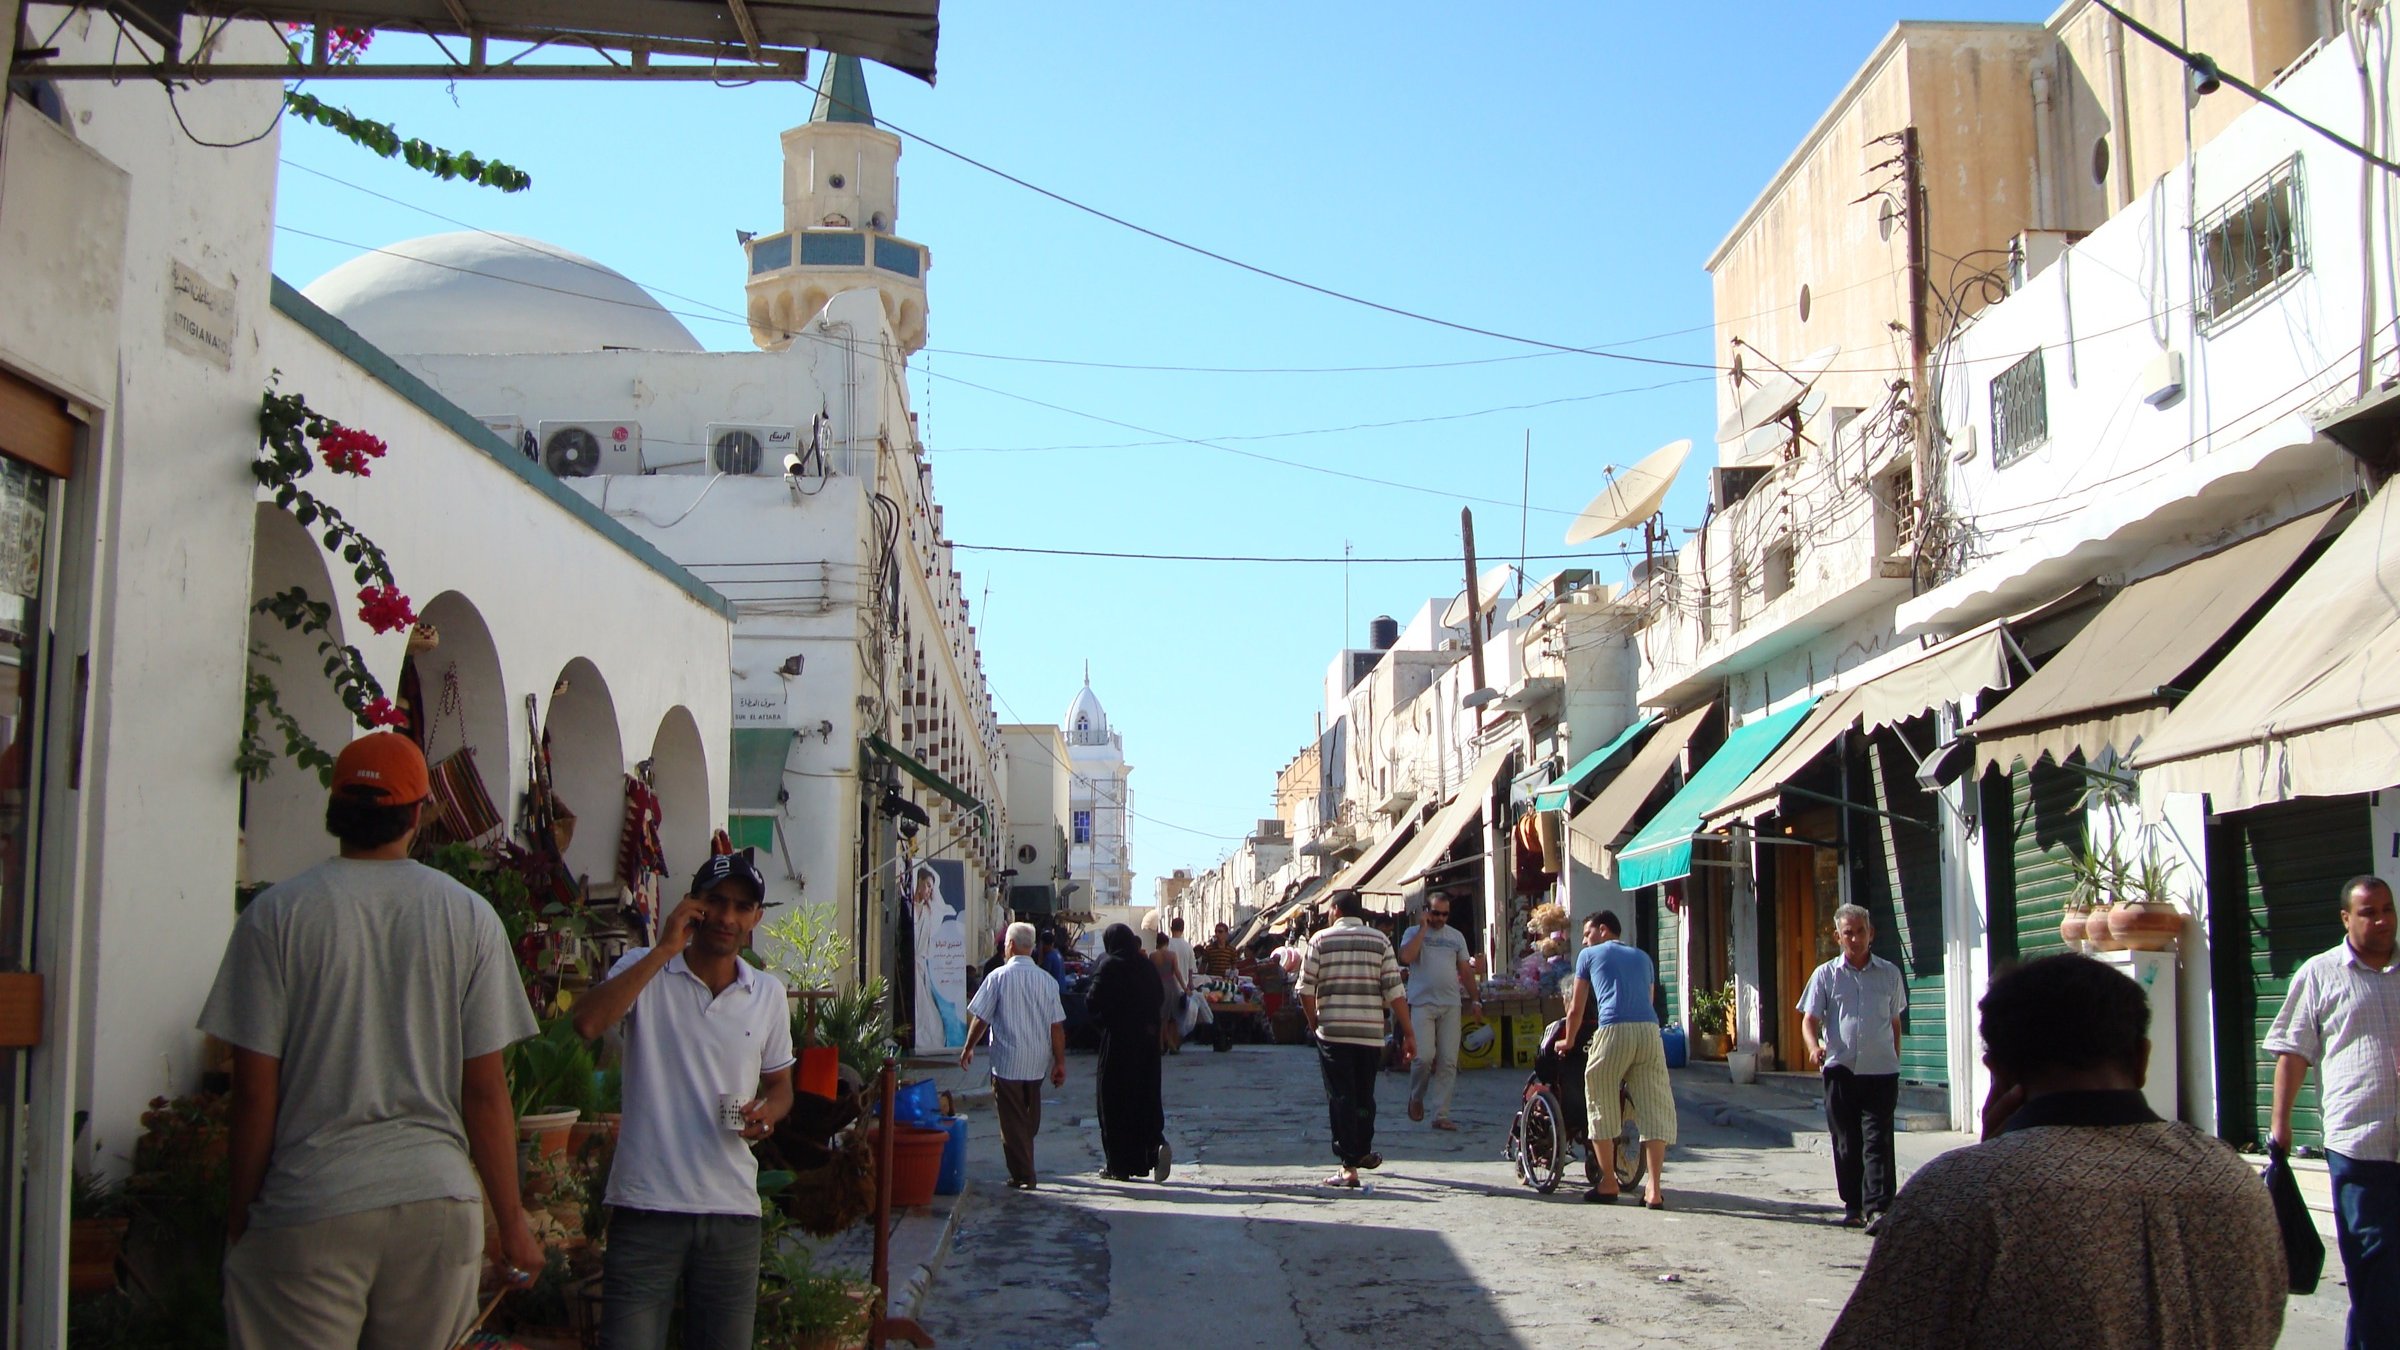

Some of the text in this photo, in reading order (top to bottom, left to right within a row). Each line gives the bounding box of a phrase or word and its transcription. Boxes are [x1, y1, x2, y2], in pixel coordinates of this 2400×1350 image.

[174, 312, 228, 354] ARTIGIANATO
[613, 443, 627, 452] LG
[760, 697, 776, 708] سوق
